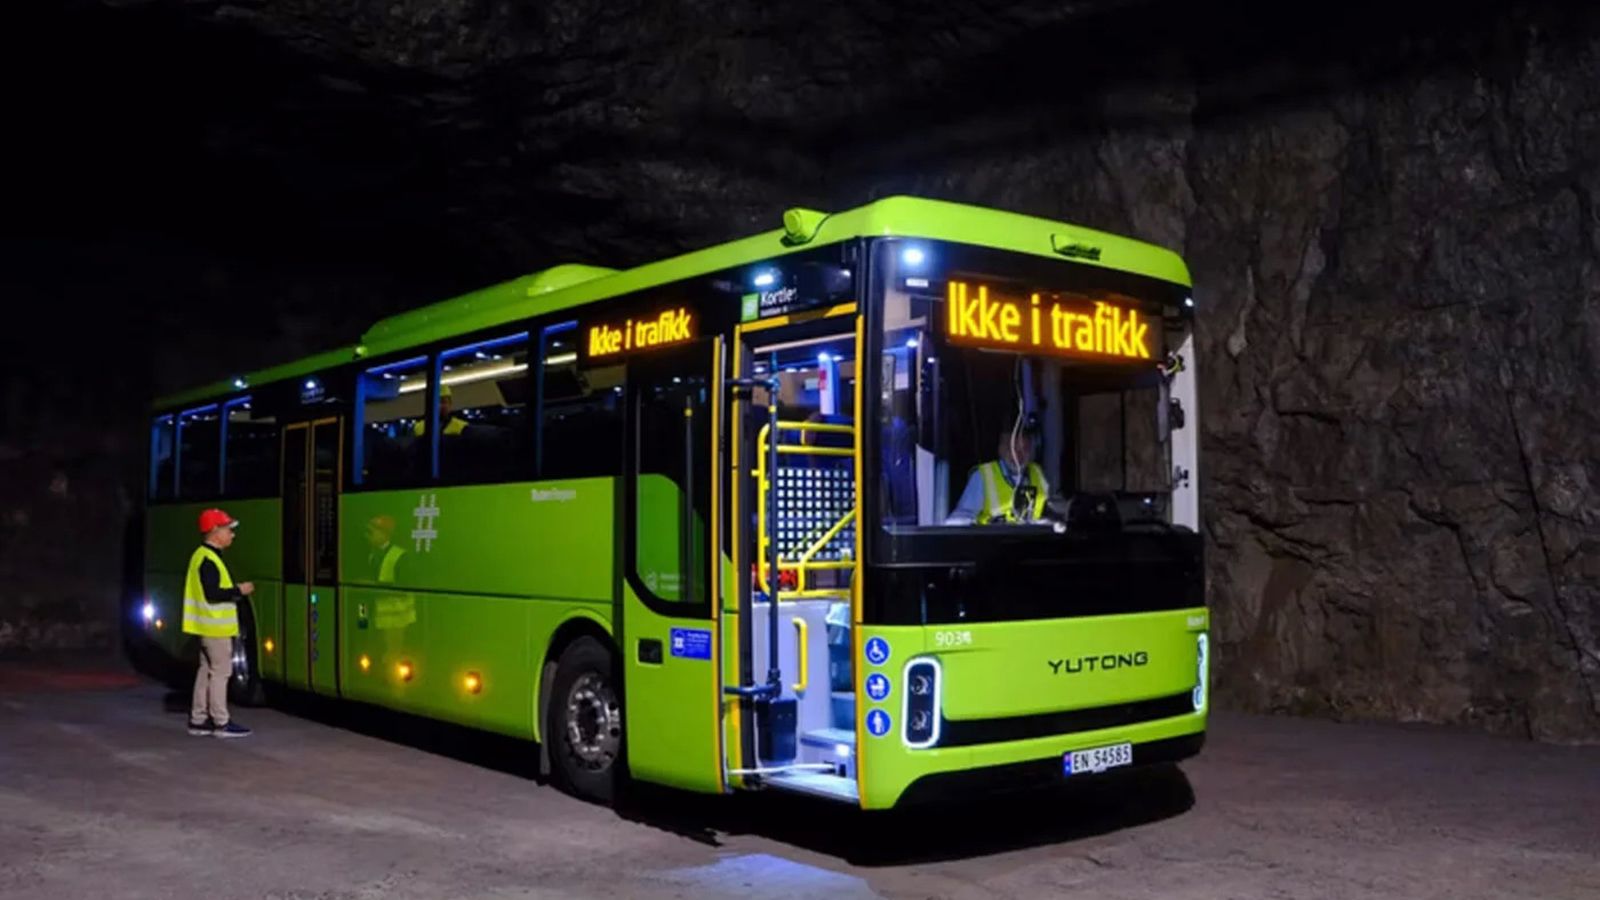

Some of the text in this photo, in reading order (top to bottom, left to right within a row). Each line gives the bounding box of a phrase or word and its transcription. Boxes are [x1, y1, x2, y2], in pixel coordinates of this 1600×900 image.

[588, 307, 692, 356] Ikke i trafikk
[948, 281, 1150, 358] Ikke i trafikk
[1048, 651, 1149, 674] YUTONG
[1073, 744, 1129, 770] EN 54585
